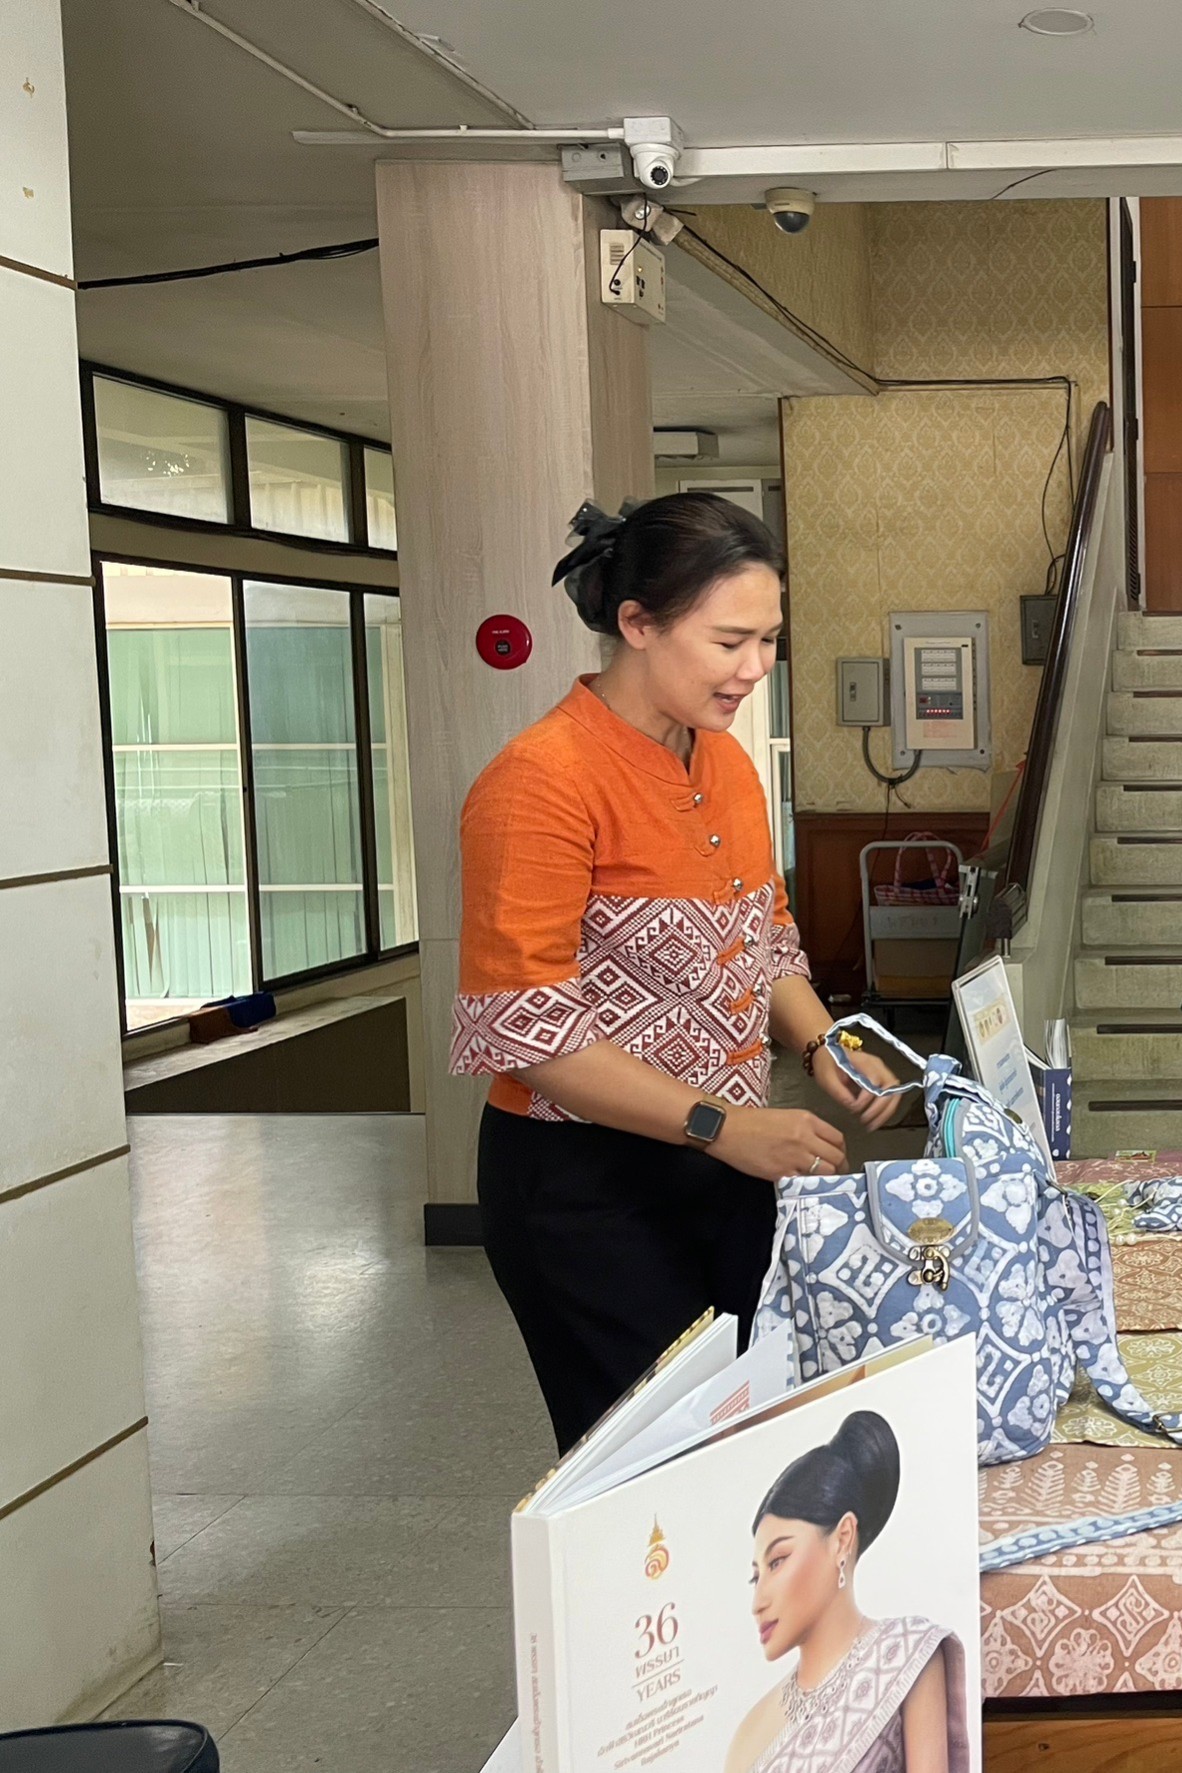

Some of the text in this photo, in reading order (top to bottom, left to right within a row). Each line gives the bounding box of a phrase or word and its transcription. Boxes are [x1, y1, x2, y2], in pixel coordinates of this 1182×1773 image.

[634, 1601, 679, 1659] 36
[635, 1646, 680, 1679] พรรษา
[636, 1668, 682, 1703] YEARS
